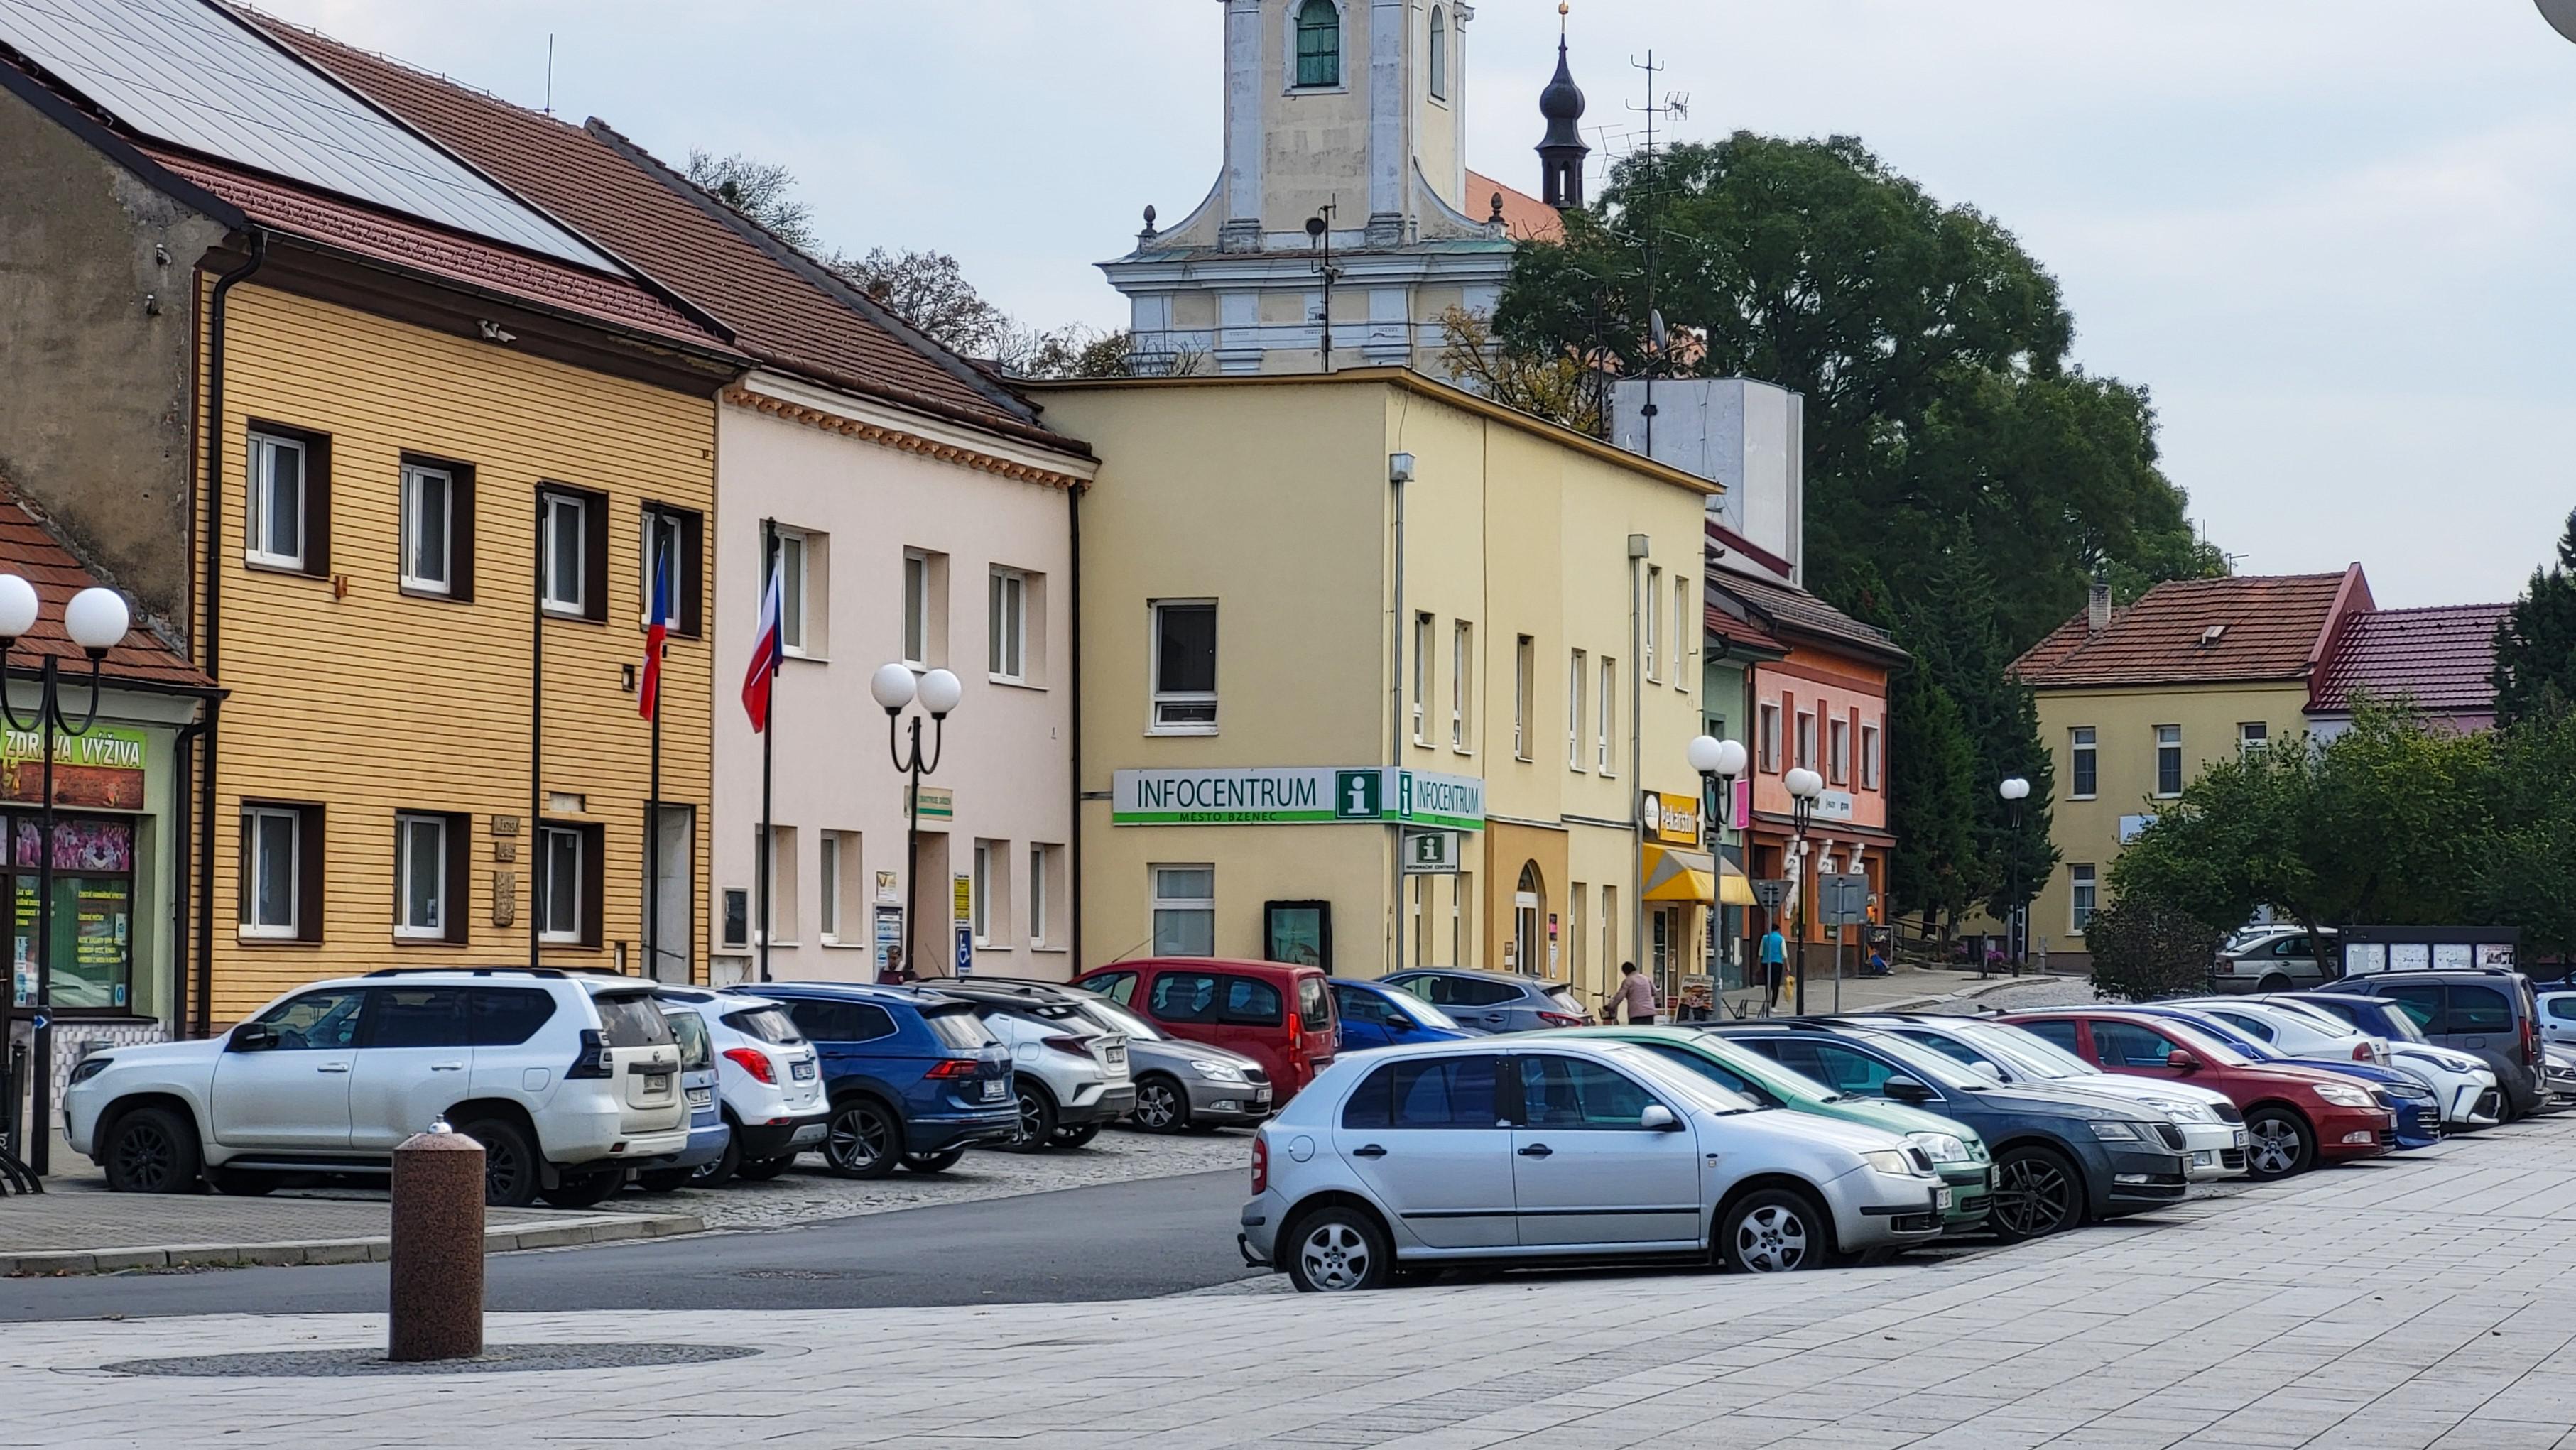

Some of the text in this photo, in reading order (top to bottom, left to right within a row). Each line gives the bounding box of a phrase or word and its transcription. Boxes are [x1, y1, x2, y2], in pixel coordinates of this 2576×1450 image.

[81, 731, 141, 768] VÝŽIVA
[1137, 778, 1317, 808] INFOCENTRUM
[1416, 780, 1479, 814] INFOCENTRUM
[1179, 811, 1277, 822] MĚSTO BZENEC
